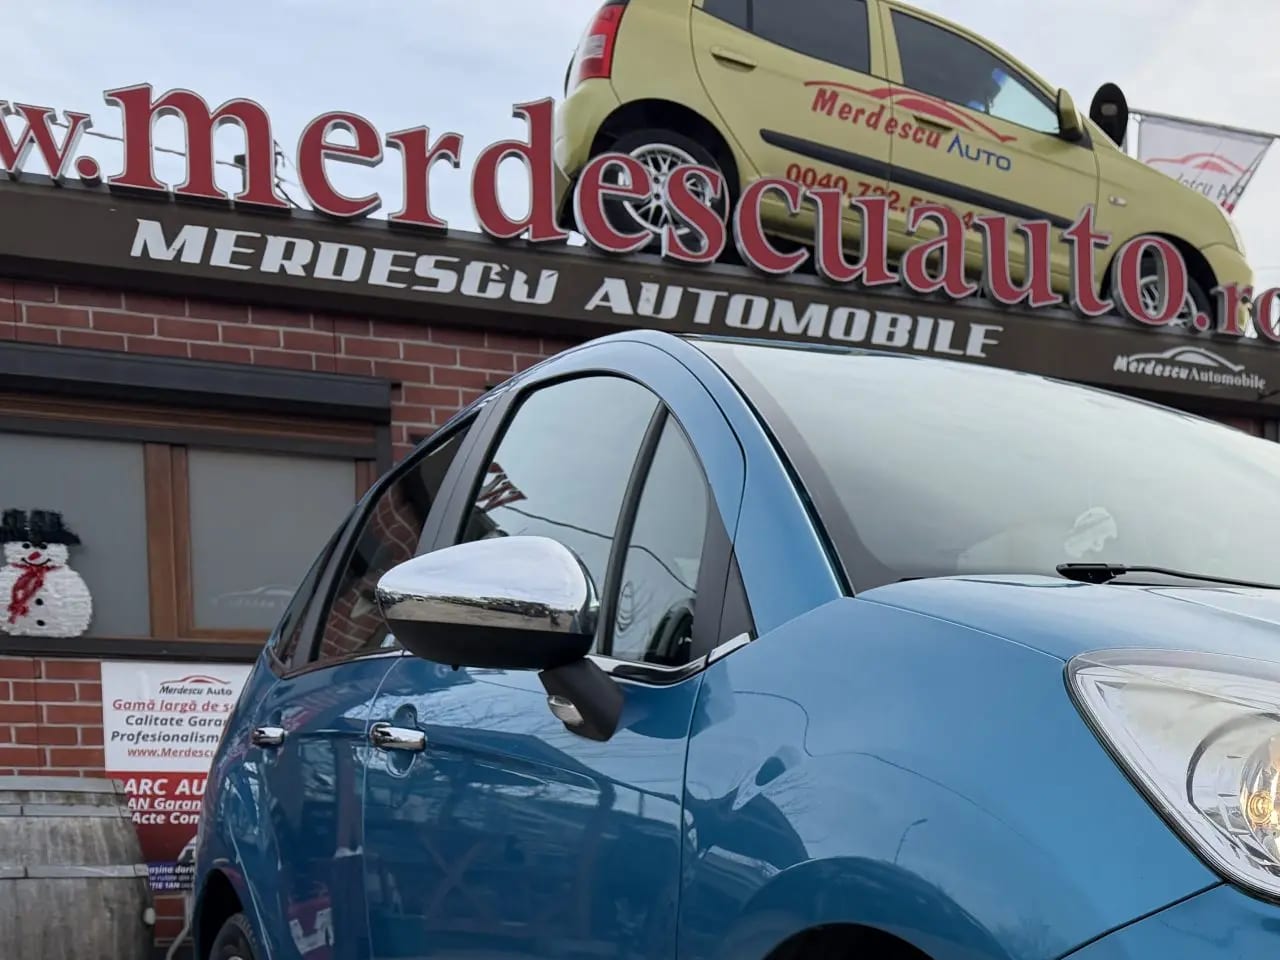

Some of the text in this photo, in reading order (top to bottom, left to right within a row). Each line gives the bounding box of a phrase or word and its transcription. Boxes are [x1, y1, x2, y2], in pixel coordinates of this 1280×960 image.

[811, 87, 943, 149] Merdescu
[130, 218, 1003, 358] MERDESCU AUTOMOBILE
[1113, 355, 1189, 380] Merdescu
[1189, 371, 1267, 390] Automobile
[159, 685, 232, 696] Merdescu Auto
[112, 699, 155, 712] Gamă
[160, 699, 197, 713] largă
[201, 701, 219, 712] de
[125, 714, 226, 727] Calitate Gara
[111, 731, 219, 745] Profesionalism
[132, 812, 166, 824] Acte
